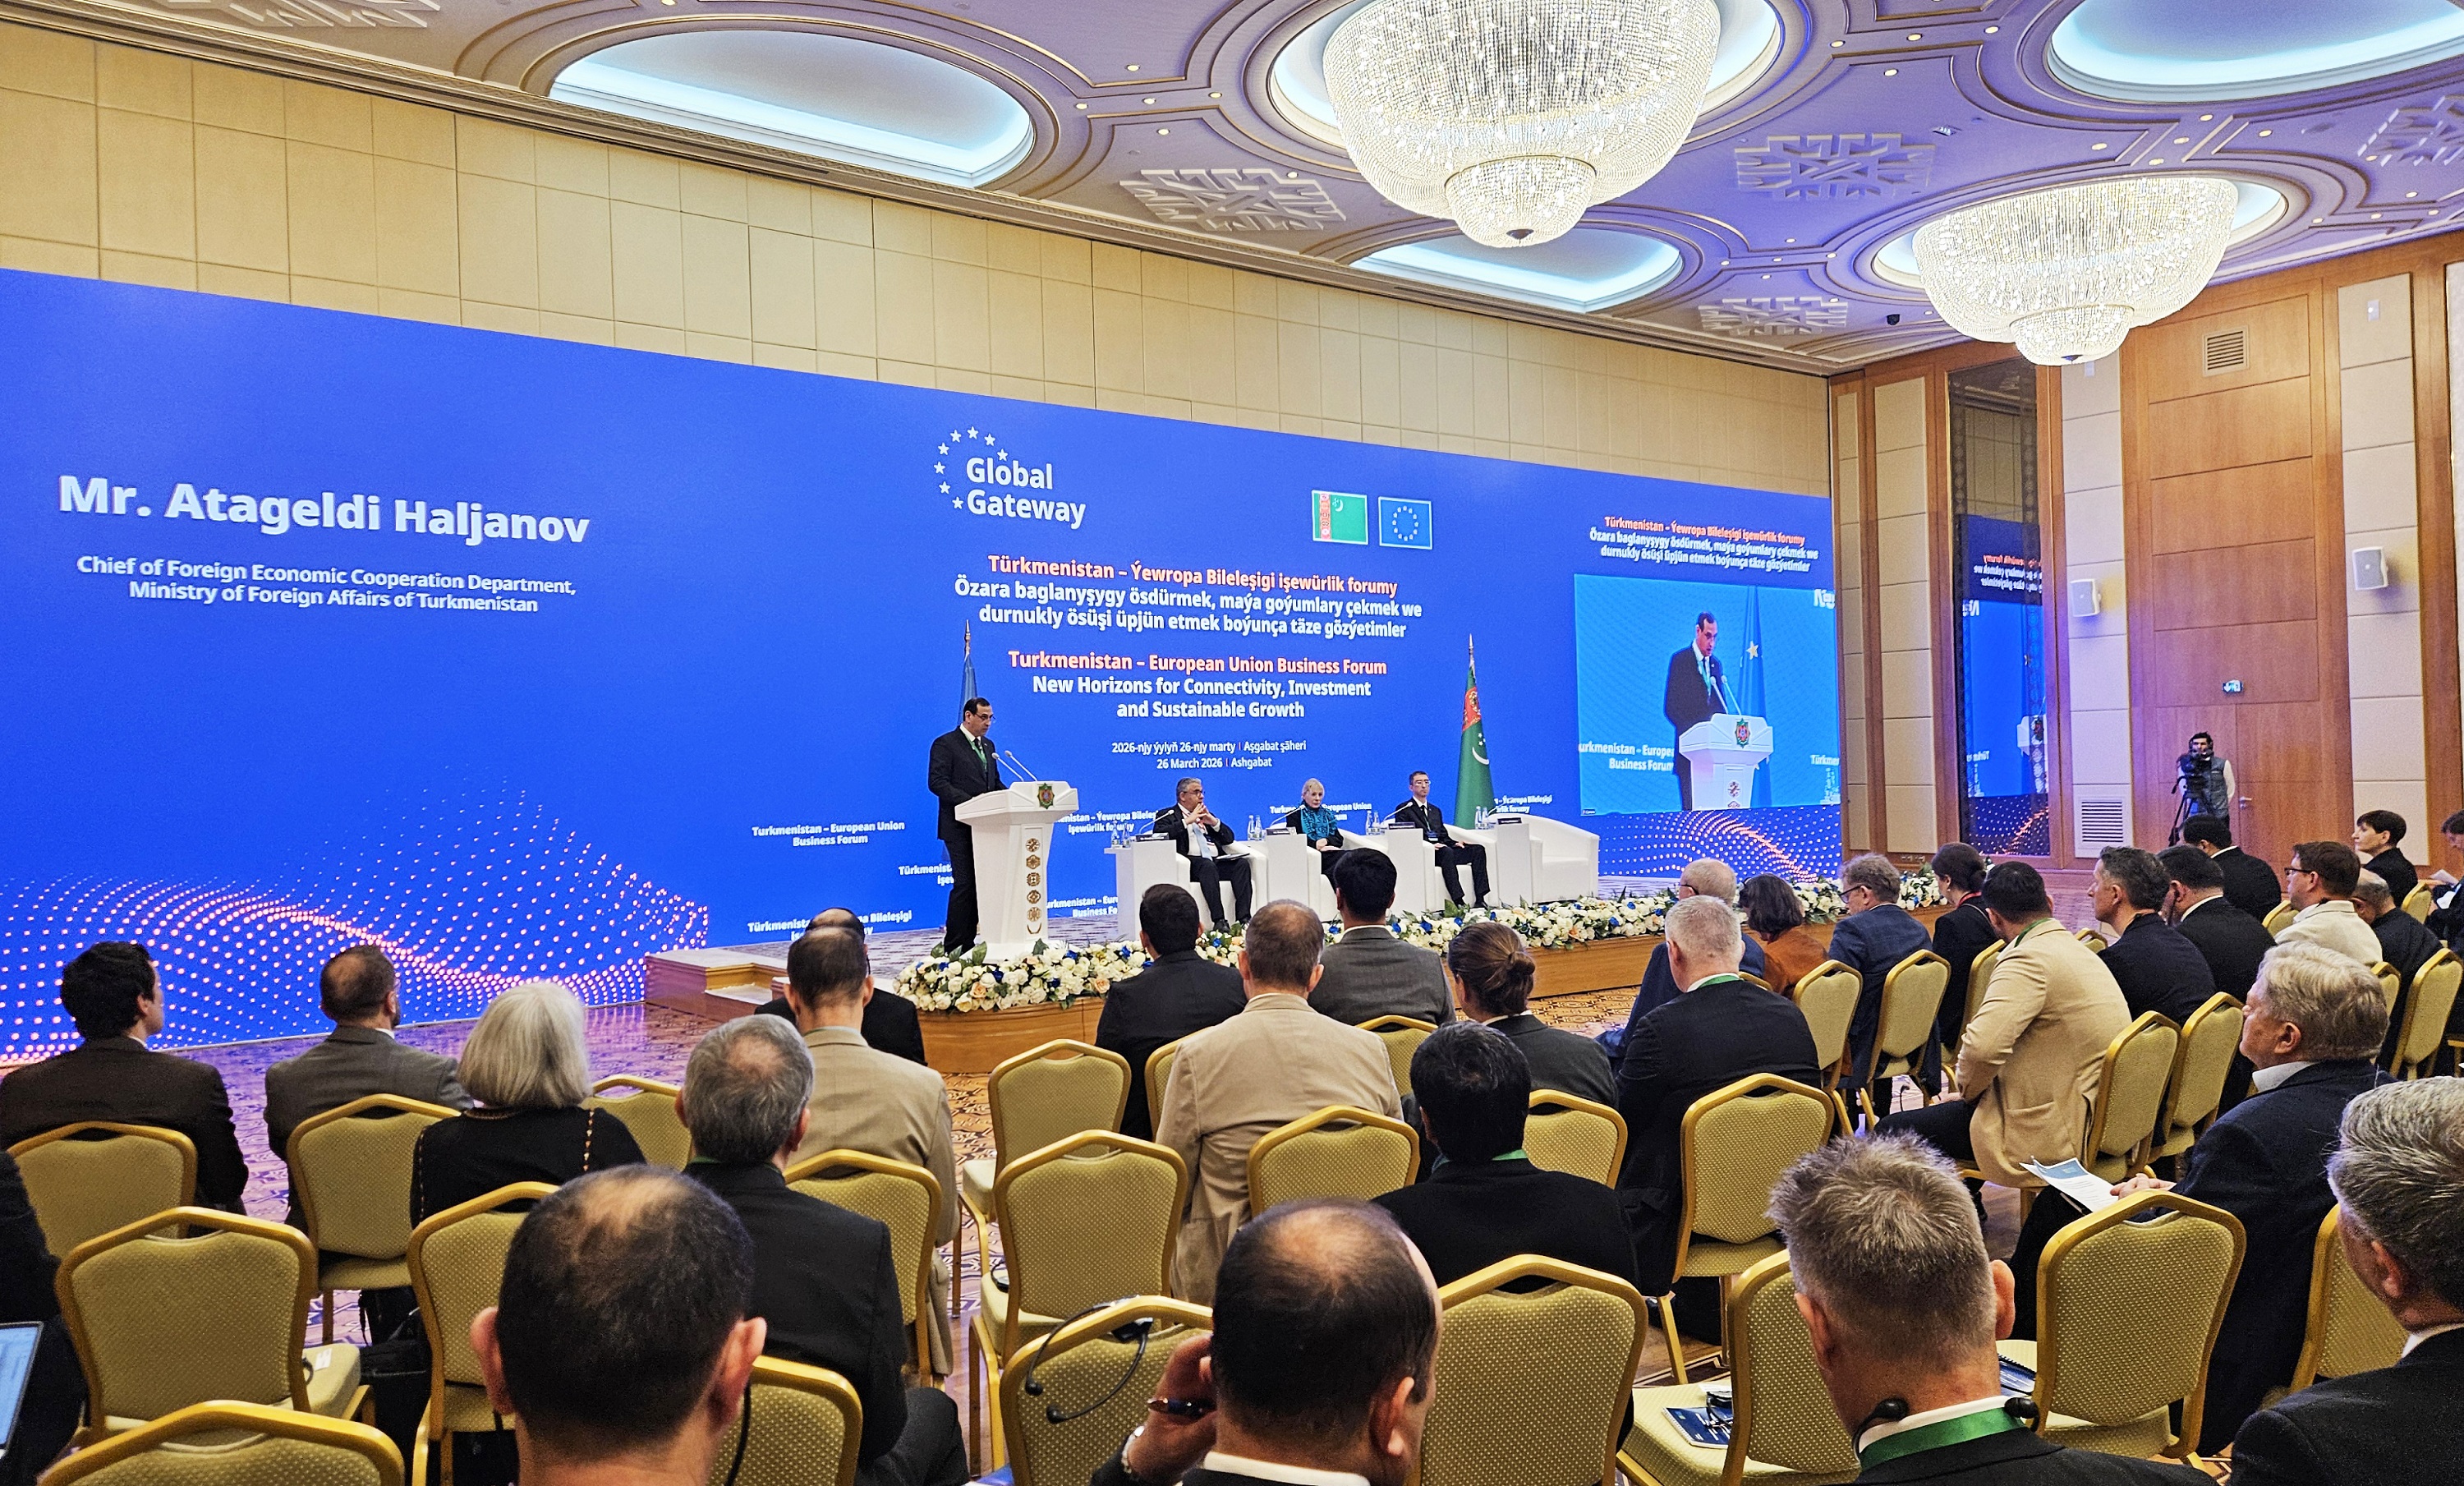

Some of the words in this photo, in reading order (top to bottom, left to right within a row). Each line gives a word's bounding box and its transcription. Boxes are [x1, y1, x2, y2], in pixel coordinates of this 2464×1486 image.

[966, 457, 1053, 490] Global
[59, 475, 152, 517] Mr.
[163, 483, 380, 535] Atageldi
[394, 499, 590, 546] Haljanov
[967, 489, 1086, 530] Gateway
[1604, 517, 1664, 531] Türkmenistan
[1671, 521, 1706, 537] Ýewropa
[1777, 532, 1805, 546] forumy
[1601, 545, 1641, 562] durnukly
[1689, 553, 1715, 565] etmek
[1713, 541, 1735, 554] maýa
[1807, 550, 1818, 559] we
[77, 555, 137, 575] Chief
[140, 559, 163, 577] of
[167, 559, 246, 582] Foreign
[251, 564, 347, 585] Economic
[351, 568, 464, 589] Cooperation
[467, 575, 577, 595] Department,
[987, 554, 1115, 578] Türkmenistan
[1130, 560, 1203, 587] Ýewropa
[1206, 568, 1276, 592] Bileleşigi
[1278, 573, 1345, 593] işewürlik
[1347, 577, 1398, 598] forumy
[129, 581, 218, 604] Ministry
[222, 584, 245, 601] of
[248, 587, 324, 608] Foreign
[327, 590, 391, 607] Affairs
[394, 591, 416, 608] of
[416, 593, 539, 612] Turkmenistan
[954, 574, 1010, 598] Özara
[1014, 580, 1126, 608] baglanyşygy
[1129, 587, 1216, 610] ösdürmek,
[1220, 593, 1262, 613] maýa
[1265, 595, 1344, 617] goýumlary
[1345, 598, 1400, 619] çekmek
[1401, 604, 1423, 617] we
[979, 604, 1064, 629] durnukly
[1067, 608, 1112, 631] ösüşi
[1116, 610, 1165, 633] üpjün
[1168, 614, 1221, 631] etmek
[1223, 614, 1288, 637] boýunça
[1290, 618, 1322, 635] täze
[1324, 619, 1407, 639] gözýetimler
[1008, 651, 1133, 669] Turkmenistan
[1149, 655, 1225, 675] European
[1229, 656, 1274, 673] Union
[1277, 657, 1340, 674] Business
[1343, 659, 1387, 674] Forum
[1032, 675, 1074, 692] New
[1078, 675, 1152, 694] Horizons
[1156, 677, 1180, 694] for
[1184, 679, 1285, 699] Connectivity,
[1288, 679, 1372, 696] Investment
[1116, 700, 1149, 718] and
[1152, 701, 1246, 718] Sustainable
[1248, 702, 1305, 718] Growth
[1111, 742, 1152, 755] 2026-njy
[1153, 742, 1179, 755] ýylyň
[1179, 741, 1207, 754] 26-njy
[1209, 742, 1236, 754] marty
[1243, 740, 1279, 753] Aşgabat
[1579, 740, 1636, 755] urkmenistan
[1642, 744, 1675, 759] Europe
[1156, 758, 1169, 769] 26
[1170, 757, 1200, 769] March
[1201, 757, 1223, 768] 2026
[1230, 756, 1273, 770] Ashgabat
[1609, 757, 1647, 771] Business
[1096, 810, 1131, 822] Ýewropa
[1353, 802, 1372, 811] Union
[752, 824, 821, 836] Turkmenistan
[830, 823, 876, 835] European
[877, 821, 905, 831] Union
[793, 835, 835, 847] Business
[837, 834, 868, 844] Forum
[898, 863, 953, 876] Türkmenist
[870, 909, 913, 923] Bileleşigi
[1072, 907, 1107, 918] Business
